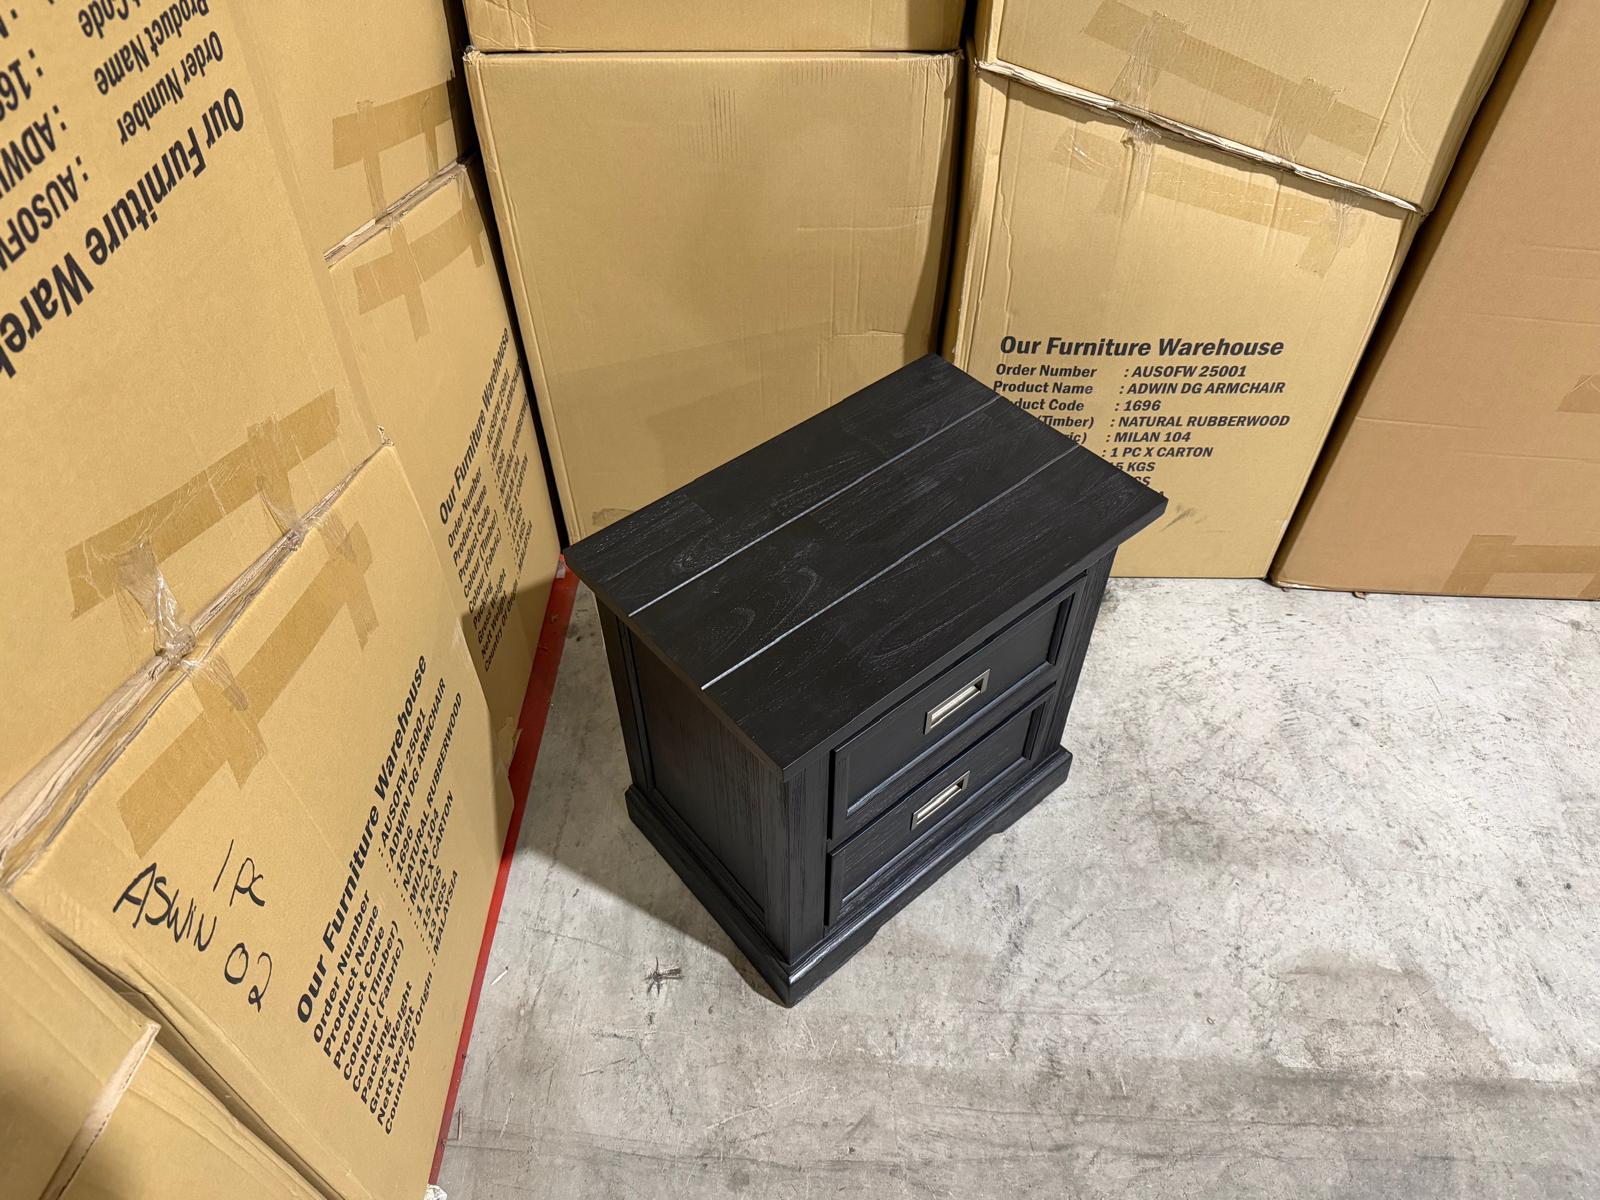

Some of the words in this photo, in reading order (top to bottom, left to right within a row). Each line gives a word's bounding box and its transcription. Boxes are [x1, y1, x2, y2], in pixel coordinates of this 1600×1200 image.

[94, 34, 150, 95] Name
[180, 31, 223, 85] Order
[117, 68, 184, 145] Number
[202, 88, 243, 149] Our
[86, 127, 206, 265] Furniture
[996, 364, 1037, 376] Order
[1039, 365, 1097, 377] Number
[1131, 366, 1198, 377] AUSOFW
[1198, 366, 1246, 377] 25001
[1001, 336, 1041, 354] Our
[1046, 337, 1151, 356] Furniture
[1159, 338, 1284, 356] Warehouse
[440, 485, 456, 525] Our
[454, 409, 485, 492] Furniture
[482, 328, 509, 412] Warehouse
[993, 381, 1049, 394] Product
[1052, 382, 1093, 394] Name
[1126, 383, 1178, 394] ADWIN
[1181, 383, 1202, 394] DG
[1204, 382, 1285, 394] ARMCHAIR
[1049, 400, 1084, 411] Code
[1124, 400, 1161, 411] 1696
[1118, 416, 1182, 427] NATURAL
[1186, 416, 1290, 427] RUBBERWOOD
[1110, 447, 1118, 457] 1
[1122, 447, 1141, 457] PC
[1143, 447, 1155, 457] X
[1157, 447, 1213, 457] CARTON
[1114, 432, 1161, 442] MILAN
[1164, 432, 1191, 442] 104
[1127, 462, 1155, 472] KGS
[448, 511, 463, 548] Order
[462, 467, 481, 515] Number
[453, 515, 474, 567] Product
[472, 485, 487, 520] Name
[458, 532, 479, 583] Product
[477, 505, 490, 535] Code
[464, 556, 480, 598] Colour
[479, 509, 498, 561] (Timber)
[469, 573, 485, 614] Colour
[484, 527, 501, 577] (Fabric)
[473, 579, 493, 630] Packing
[478, 608, 492, 645] Gross
[490, 568, 506, 610] Weight
[481, 629, 492, 660] Nett
[491, 590, 507, 632] Weight
[485, 625, 502, 672] Country
[502, 608, 508, 627] Of
[506, 579, 518, 612] Origin
[297, 954, 326, 1023] Our
[323, 806, 379, 953] Furniture
[374, 656, 426, 801] Warehouse
[314, 976, 340, 1043] Order
[337, 890, 369, 976] Number
[381, 763, 408, 848] AUSOFW
[406, 708, 426, 766] 25001
[323, 967, 358, 1057] Product
[355, 905, 378, 966] Name
[389, 795, 410, 864] ADWIN
[408, 767, 419, 797] DG
[418, 678, 445, 770] ARMCHAIR
[344, 1007, 370, 1080] Colour
[368, 921, 398, 1006] (Timber)
[403, 811, 429, 892] NATURAL
[427, 692, 461, 809] RUBBERWOOD
[333, 981, 367, 1070] Product
[364, 926, 384, 978] Code
[397, 825, 413, 876] 1696
[353, 1020, 378, 1092] Colour
[376, 932, 404, 1018] (Fabric)
[410, 844, 429, 906] MILAN
[427, 808, 439, 844] 104
[361, 1015, 391, 1105] Packing
[417, 905, 423, 918] 1
[420, 874, 429, 903] PC
[428, 859, 434, 876] X
[432, 790, 453, 859] CARTON
[370, 1054, 390, 1113] Gross
[388, 981, 412, 1049] Weight
[423, 905, 431, 931] 15
[429, 865, 441, 905] KGS
[377, 1078, 394, 1126] Nett
[391, 1006, 414, 1074] Weight
[429, 918, 436, 943] 13
[435, 878, 446, 917] KGS
[386, 1055, 410, 1134] Country
[409, 1026, 416, 1052] Of
[415, 972, 432, 1025] Origin
[433, 870, 457, 956] MALAYSIA
